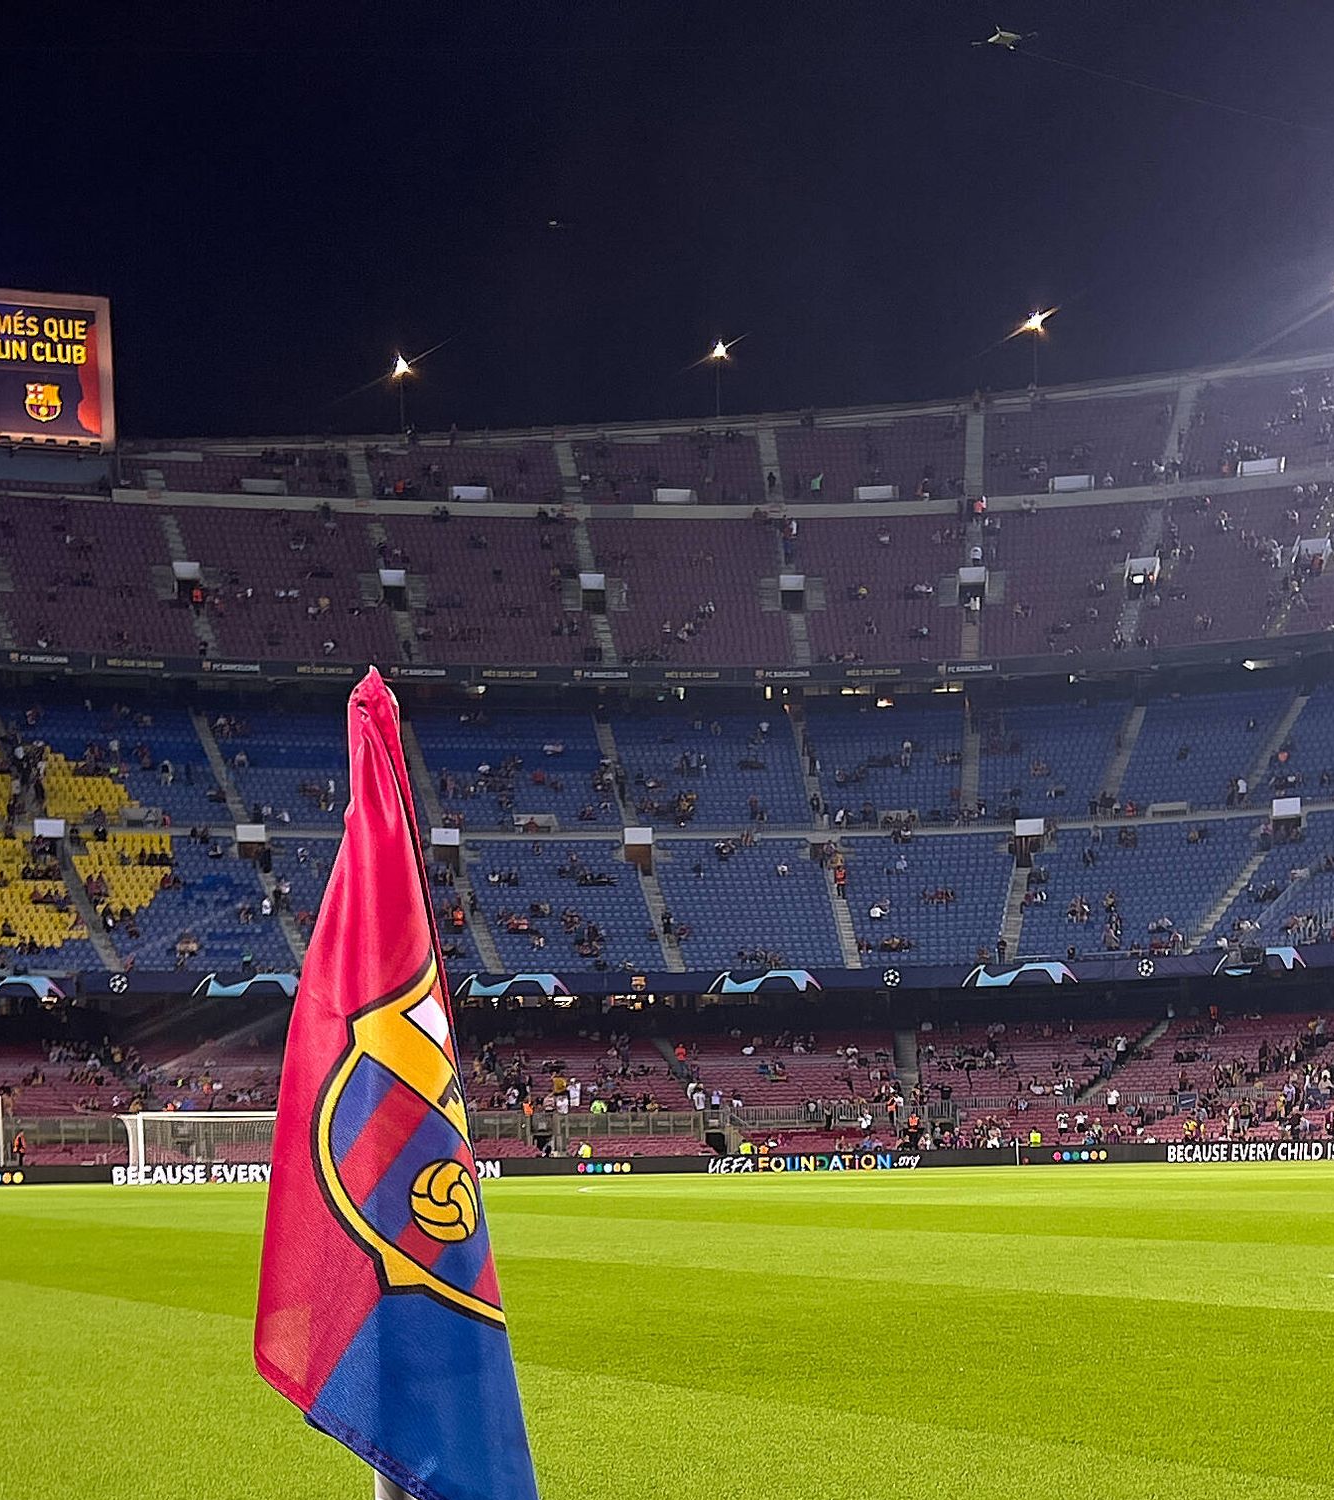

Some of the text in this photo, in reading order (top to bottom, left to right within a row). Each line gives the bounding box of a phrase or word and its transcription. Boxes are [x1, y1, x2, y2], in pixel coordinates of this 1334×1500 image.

[44, 317, 87, 342] QUE
[31, 341, 87, 365] CLUB
[1167, 1144, 1227, 1162] BECAUSE
[1231, 1142, 1274, 1161] EVERY
[1277, 1142, 1323, 1161] CHILD
[112, 1163, 272, 1186] BECAUSE EVERY
[708, 1156, 754, 1174] UEFA
